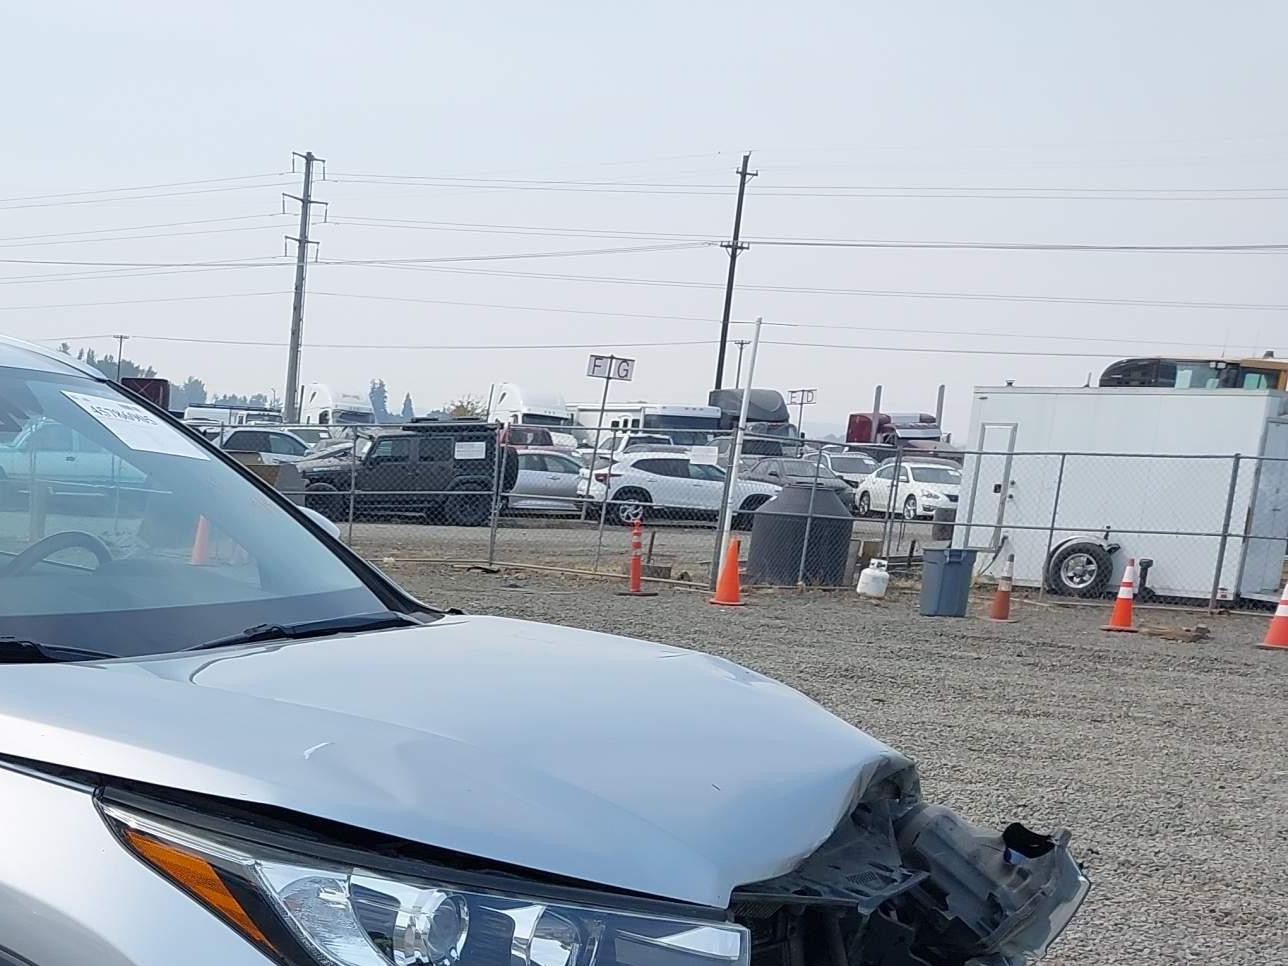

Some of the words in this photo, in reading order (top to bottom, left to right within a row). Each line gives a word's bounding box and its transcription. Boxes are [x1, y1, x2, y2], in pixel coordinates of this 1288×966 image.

[592, 357, 604, 375] F
[617, 360, 630, 379] G
[790, 391, 798, 405] E
[806, 390, 815, 403] D
